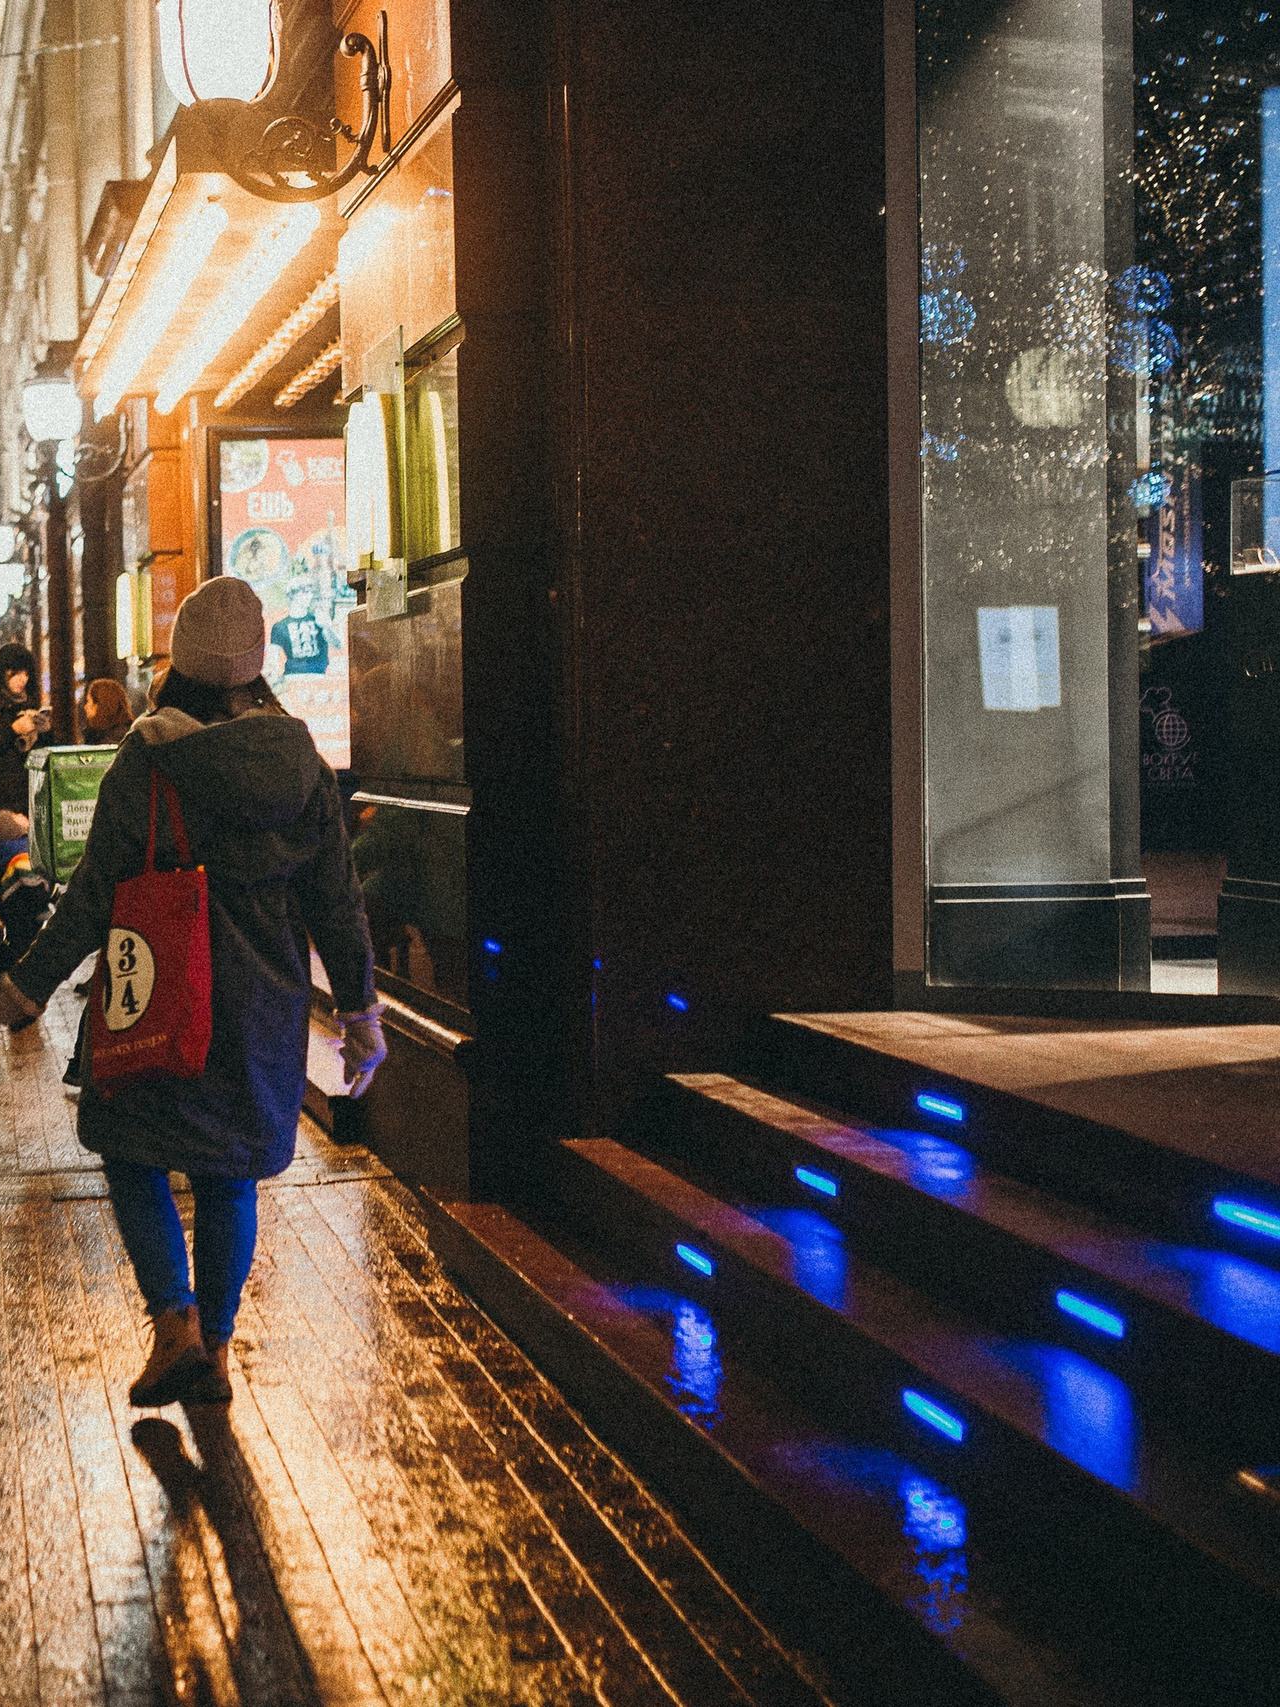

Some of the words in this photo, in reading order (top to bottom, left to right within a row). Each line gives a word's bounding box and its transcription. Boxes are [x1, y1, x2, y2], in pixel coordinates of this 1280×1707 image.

[247, 491, 294, 518] ЕШЬ
[1148, 767, 1195, 780] СВЕТА
[118, 938, 136, 972] 3
[121, 980, 139, 1015] 4
